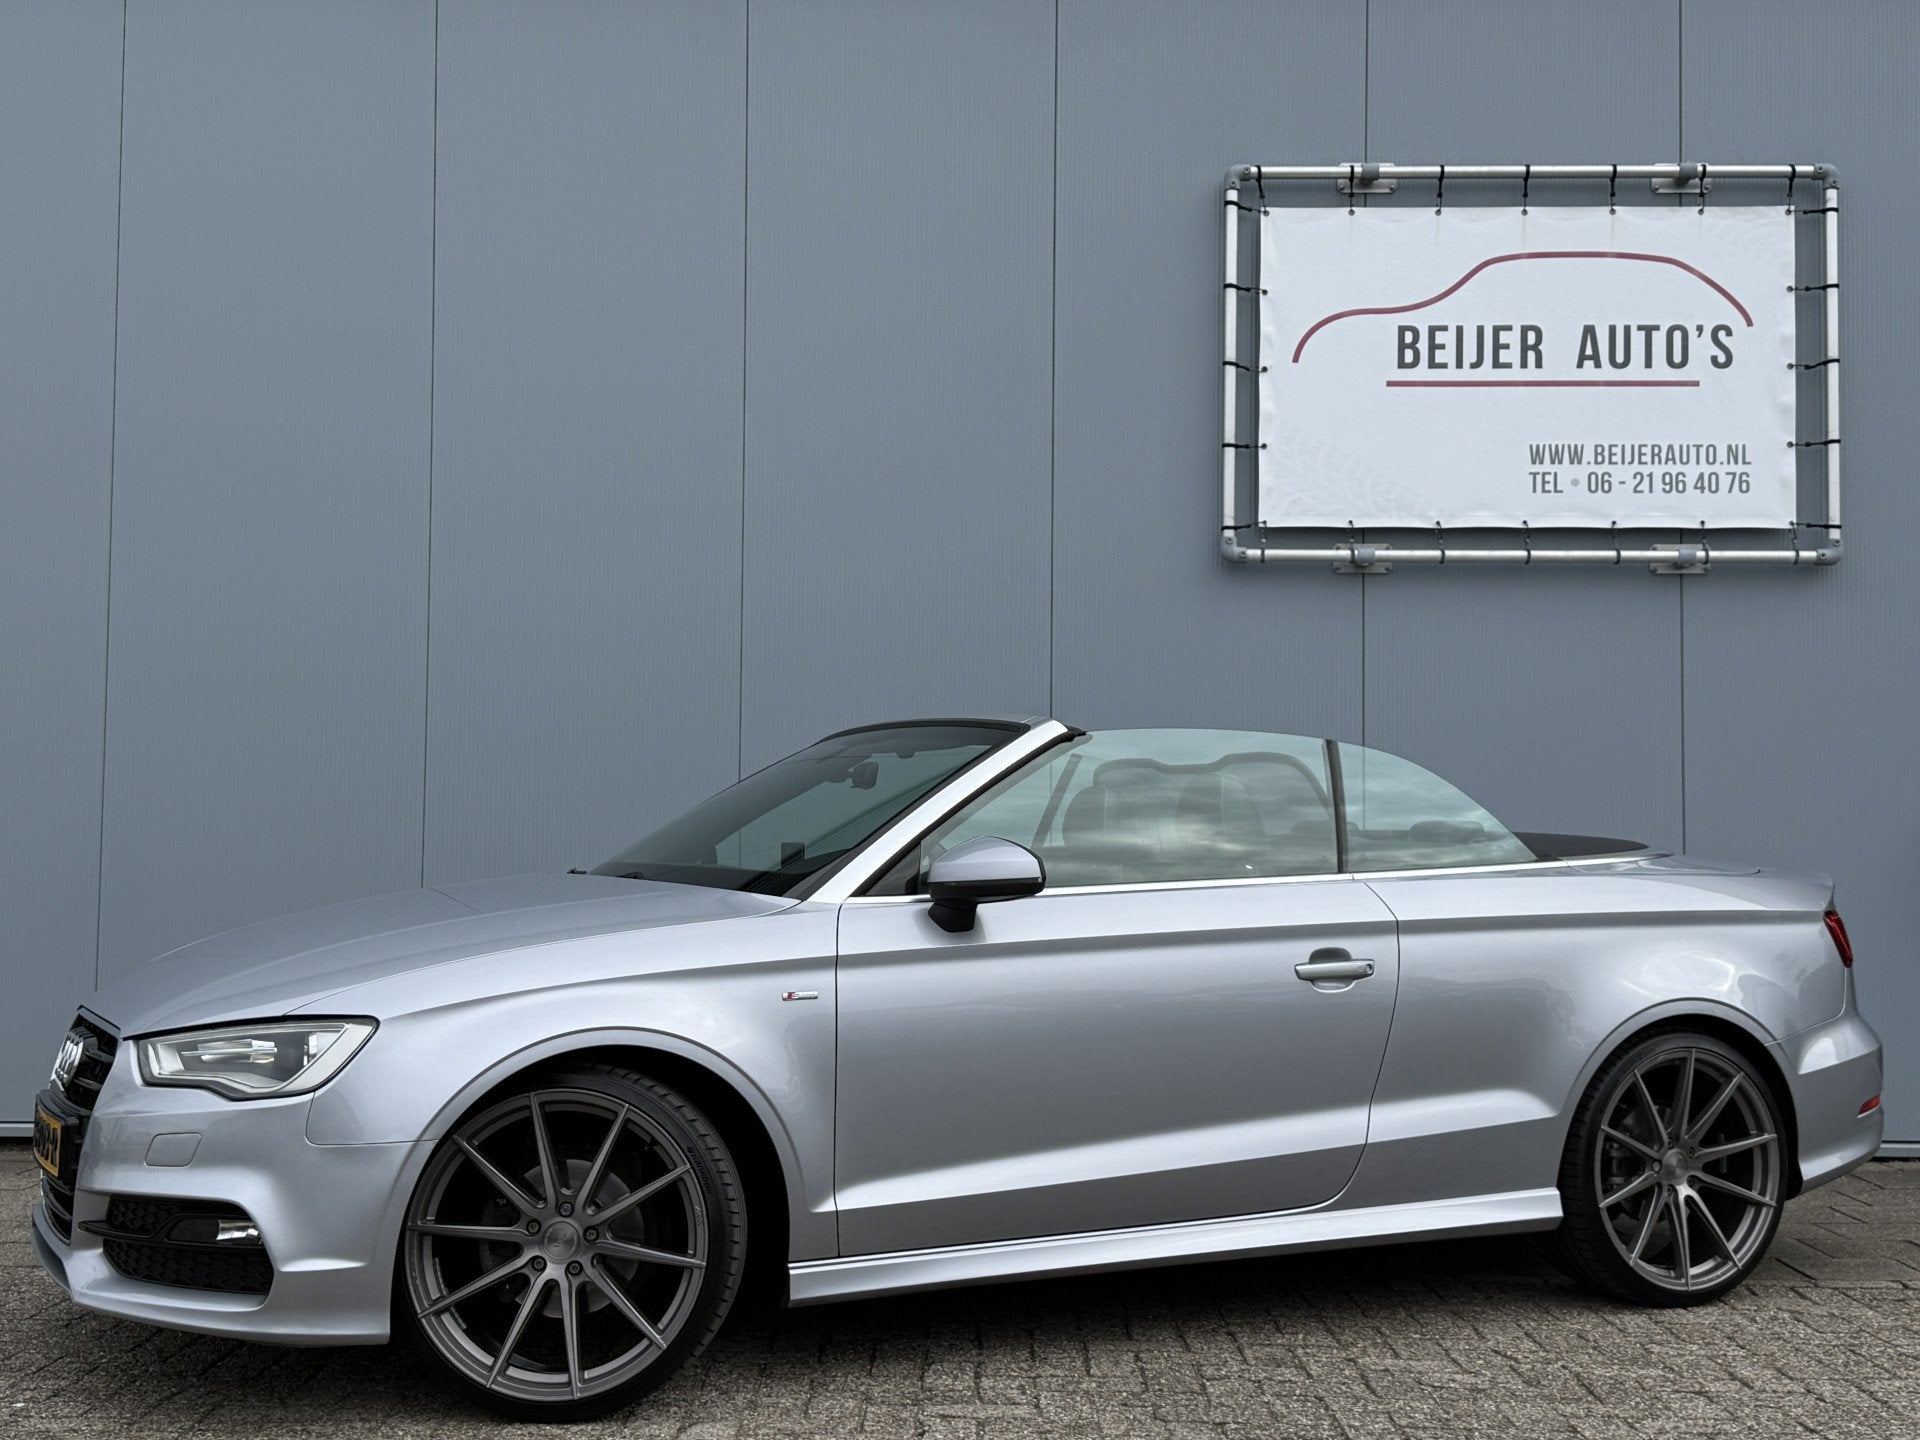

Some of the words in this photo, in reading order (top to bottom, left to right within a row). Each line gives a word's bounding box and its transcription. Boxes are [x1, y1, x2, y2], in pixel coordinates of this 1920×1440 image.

[1397, 324, 1543, 369] BEIJER
[1575, 324, 1734, 369] AUTO'S
[1528, 443, 1752, 466] WWW.BEIJERAUTO.NL
[1528, 471, 1564, 494] TEL
[1587, 471, 1613, 494] 06
[1632, 471, 1654, 494] 21
[1661, 471, 1687, 494] 96
[1693, 471, 1720, 494] 40
[1725, 471, 1751, 494] 76
